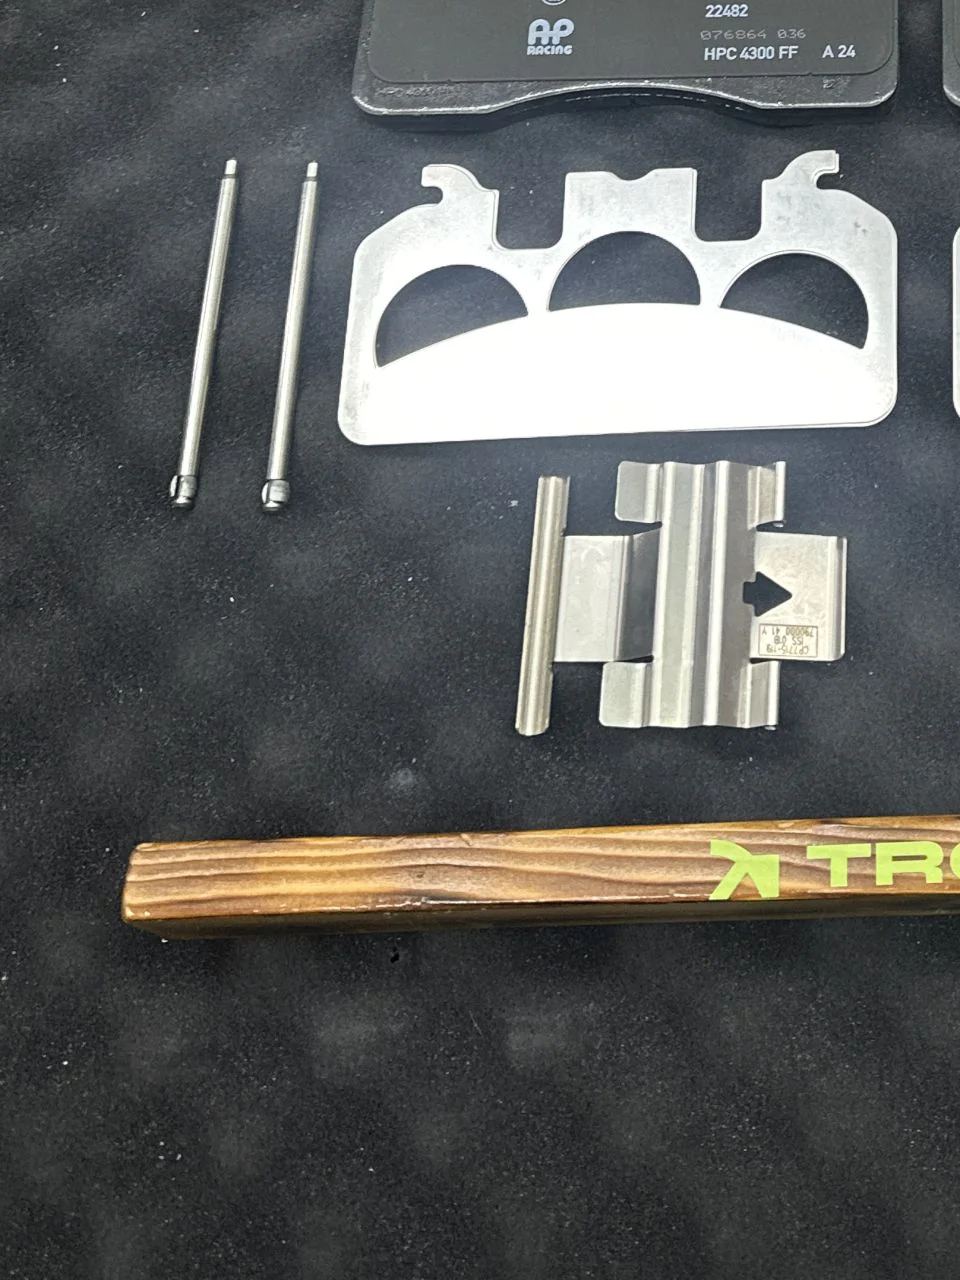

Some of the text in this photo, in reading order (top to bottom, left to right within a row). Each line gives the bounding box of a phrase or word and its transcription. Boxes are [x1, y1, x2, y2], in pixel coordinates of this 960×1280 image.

[704, 3, 749, 18] 22482
[528, 17, 575, 43] AP
[699, 28, 807, 41] 076864 036
[527, 43, 572, 55] RACING
[703, 44, 857, 61] HPC 4300 FF A 24
